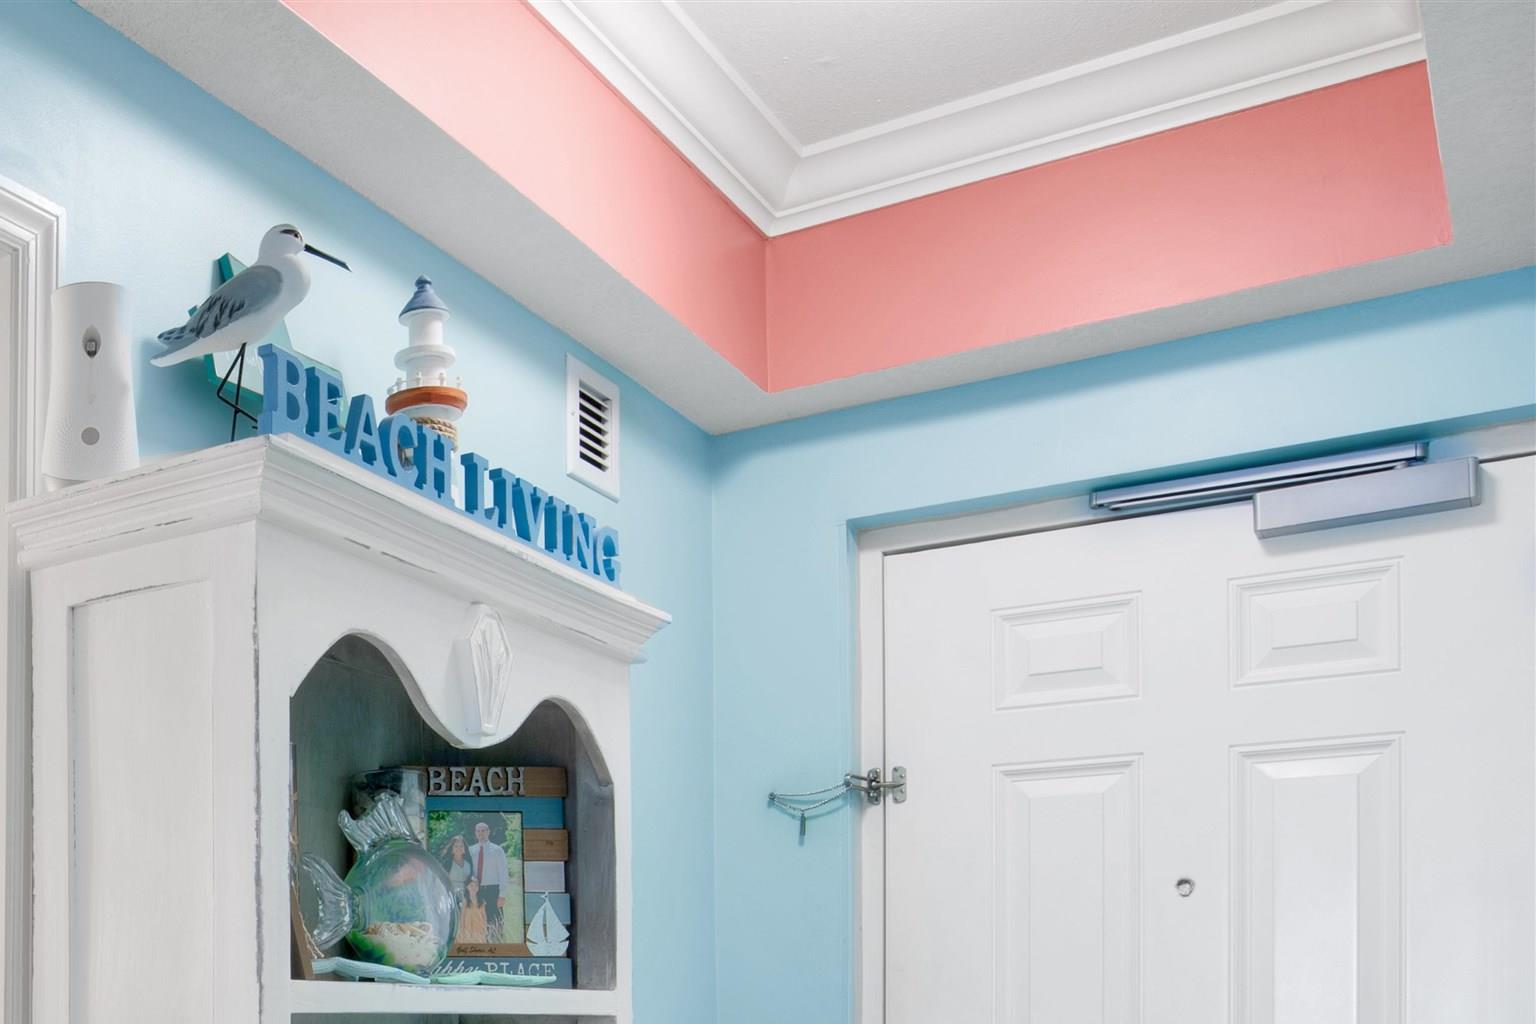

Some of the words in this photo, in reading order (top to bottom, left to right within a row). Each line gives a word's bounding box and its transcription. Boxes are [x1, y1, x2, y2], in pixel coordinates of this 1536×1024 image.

[257, 343, 455, 508] BEACH
[460, 452, 621, 586] LIVING
[427, 766, 525, 796] BEACH
